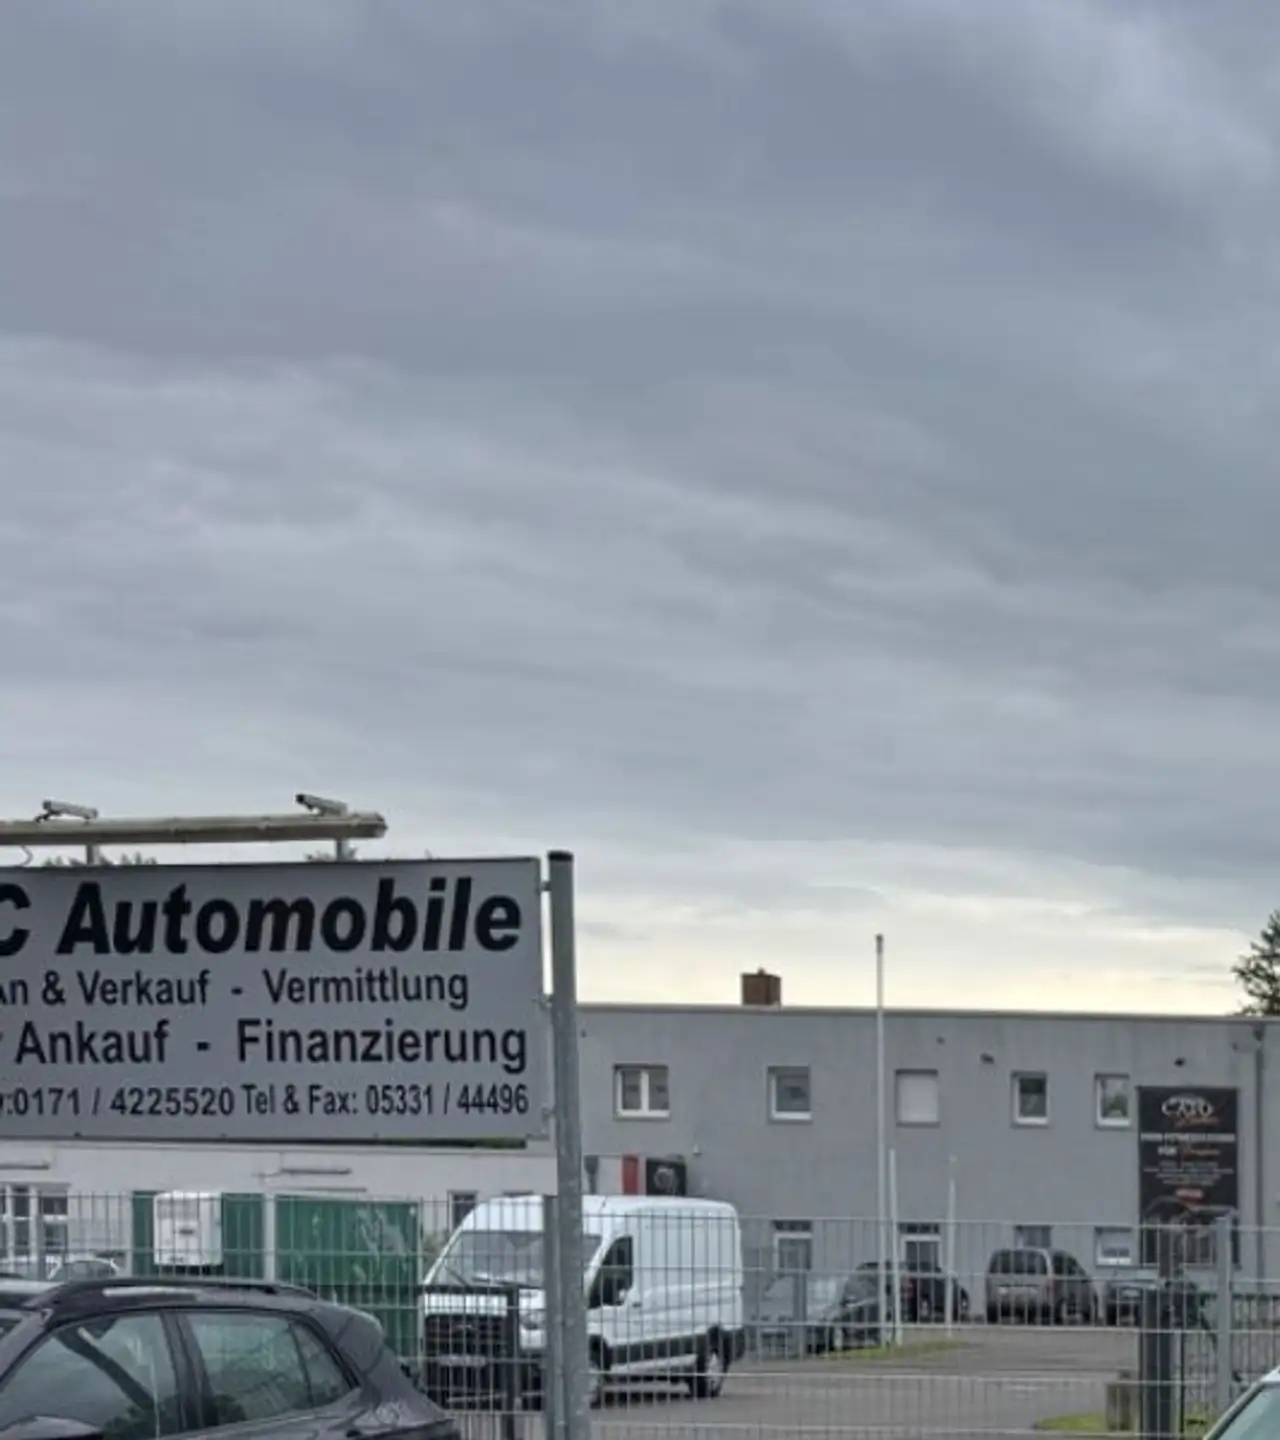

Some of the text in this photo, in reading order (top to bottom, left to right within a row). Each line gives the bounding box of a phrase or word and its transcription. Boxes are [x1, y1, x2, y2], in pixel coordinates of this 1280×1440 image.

[55, 876, 522, 955] Automobile
[42, 969, 66, 1006] &
[76, 968, 211, 1006] Verkauf
[262, 966, 468, 1011] Vermittlung
[14, 1019, 170, 1064] Ankauf
[237, 1017, 527, 1075] Finanzierung
[109, 1086, 235, 1117] 4225520
[241, 1083, 276, 1114] Tel
[284, 1083, 300, 1115] &
[308, 1083, 359, 1115] Fax:
[365, 1083, 434, 1115] 05331
[456, 1083, 529, 1115] 44496
